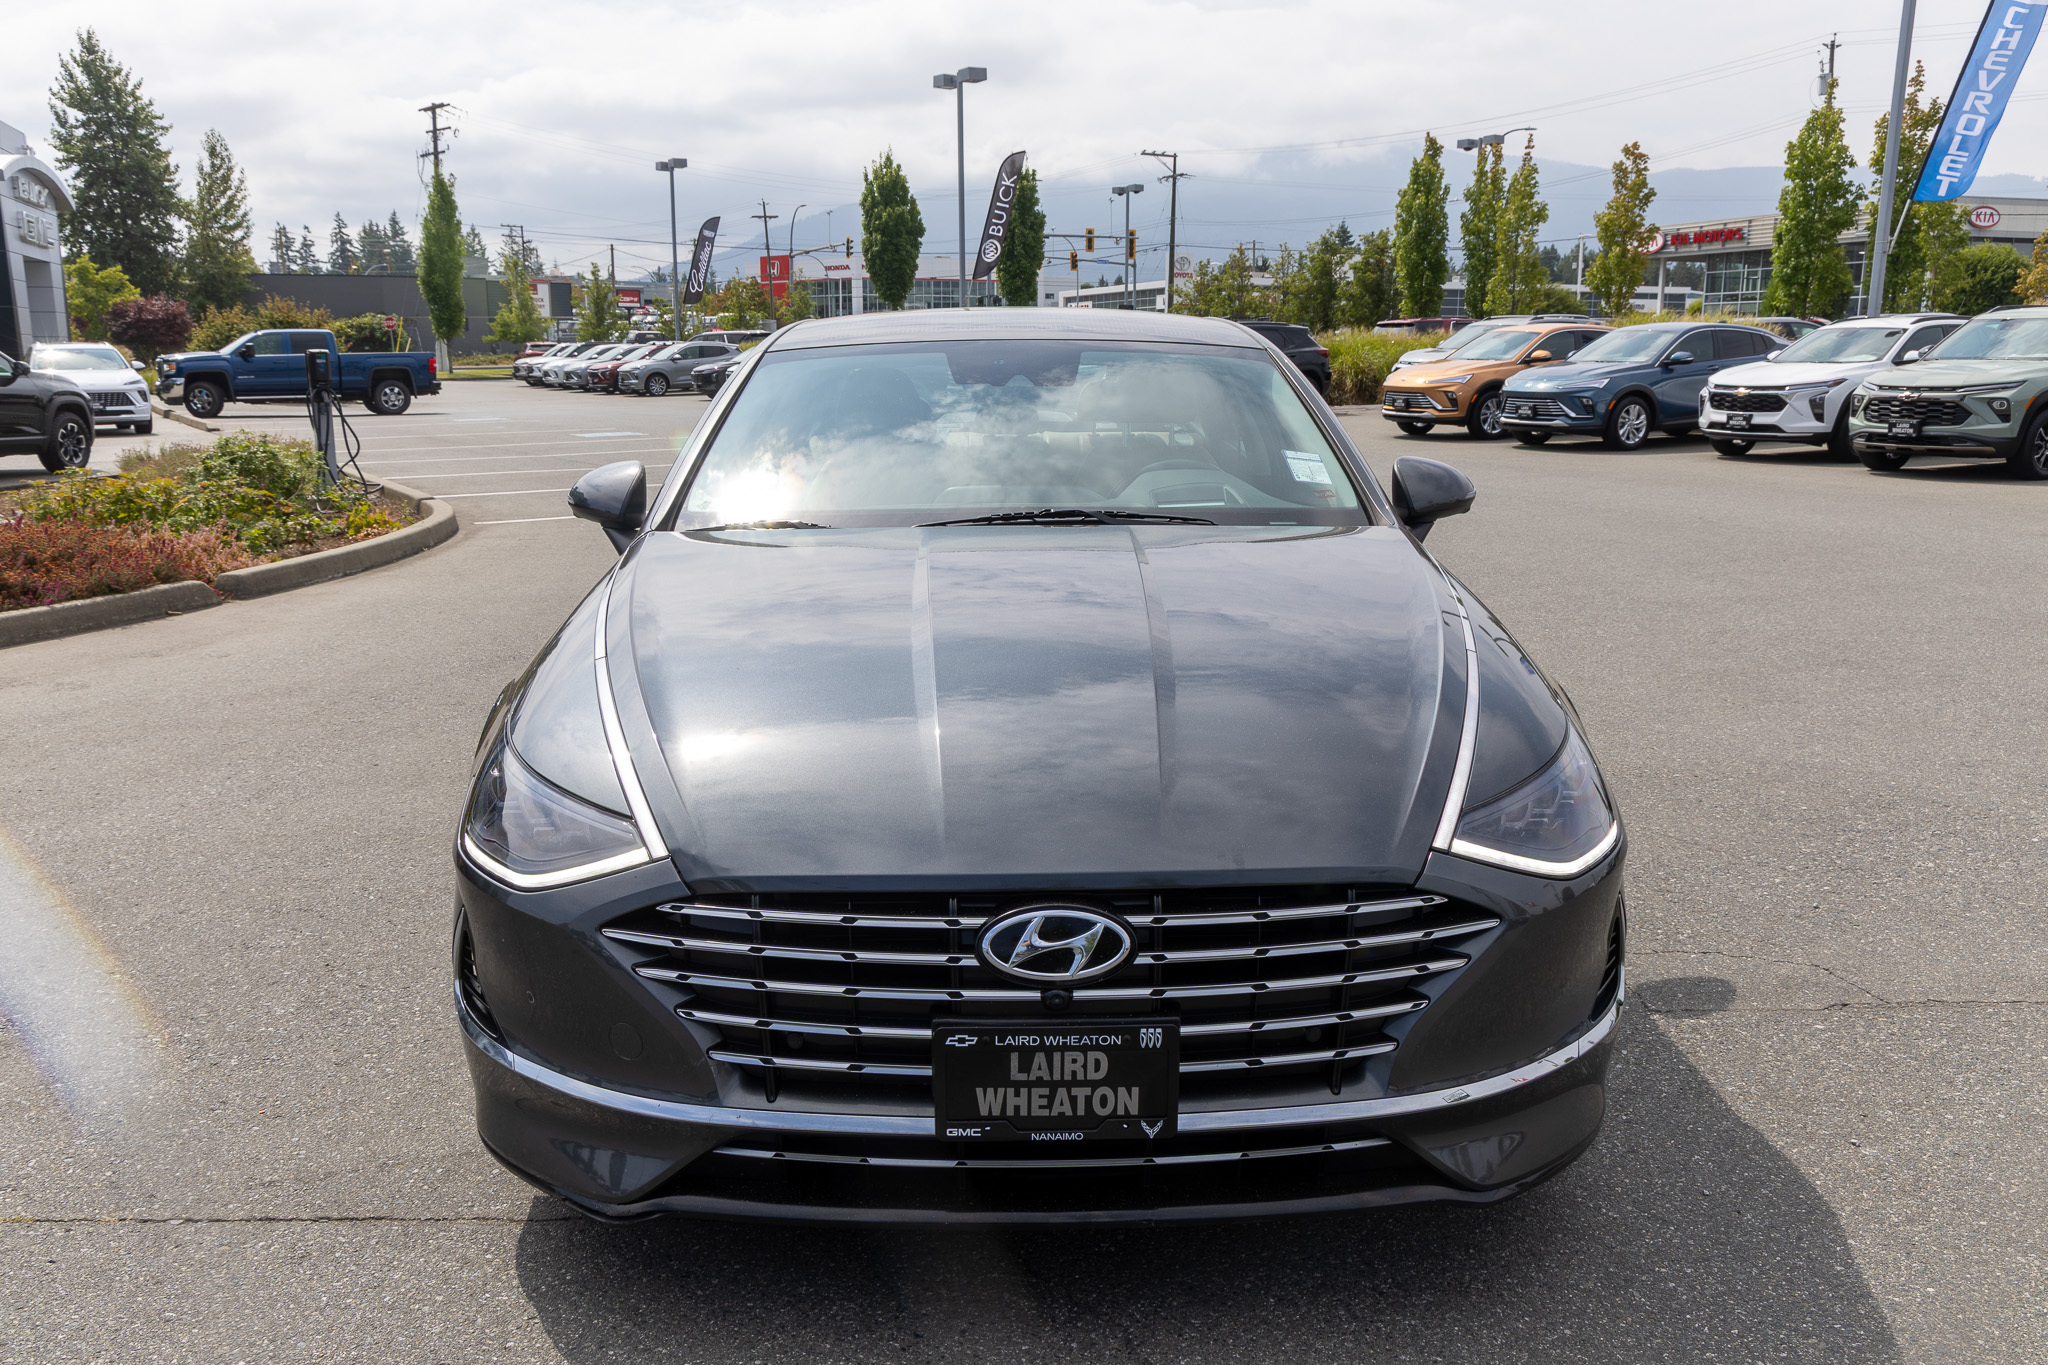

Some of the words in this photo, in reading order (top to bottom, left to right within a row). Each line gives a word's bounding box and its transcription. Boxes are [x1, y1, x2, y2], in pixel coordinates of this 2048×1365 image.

[1936, 5, 2030, 197] CHEVROLET
[988, 172, 1018, 237] BUICK
[1975, 210, 1995, 223] KIA
[1670, 232, 1689, 246] KIA
[1692, 227, 1743, 244] MOTORS
[689, 241, 712, 293] Cadillac
[1174, 271, 1194, 280] OYOTA
[994, 1035, 1040, 1046] LAIRD
[1043, 1035, 1122, 1046] WHEATON
[1009, 1051, 1109, 1081] LAIRD
[975, 1086, 1140, 1117] WHEATON
[946, 1128, 982, 1137] GMC
[1031, 1132, 1084, 1141] NANAIMO
